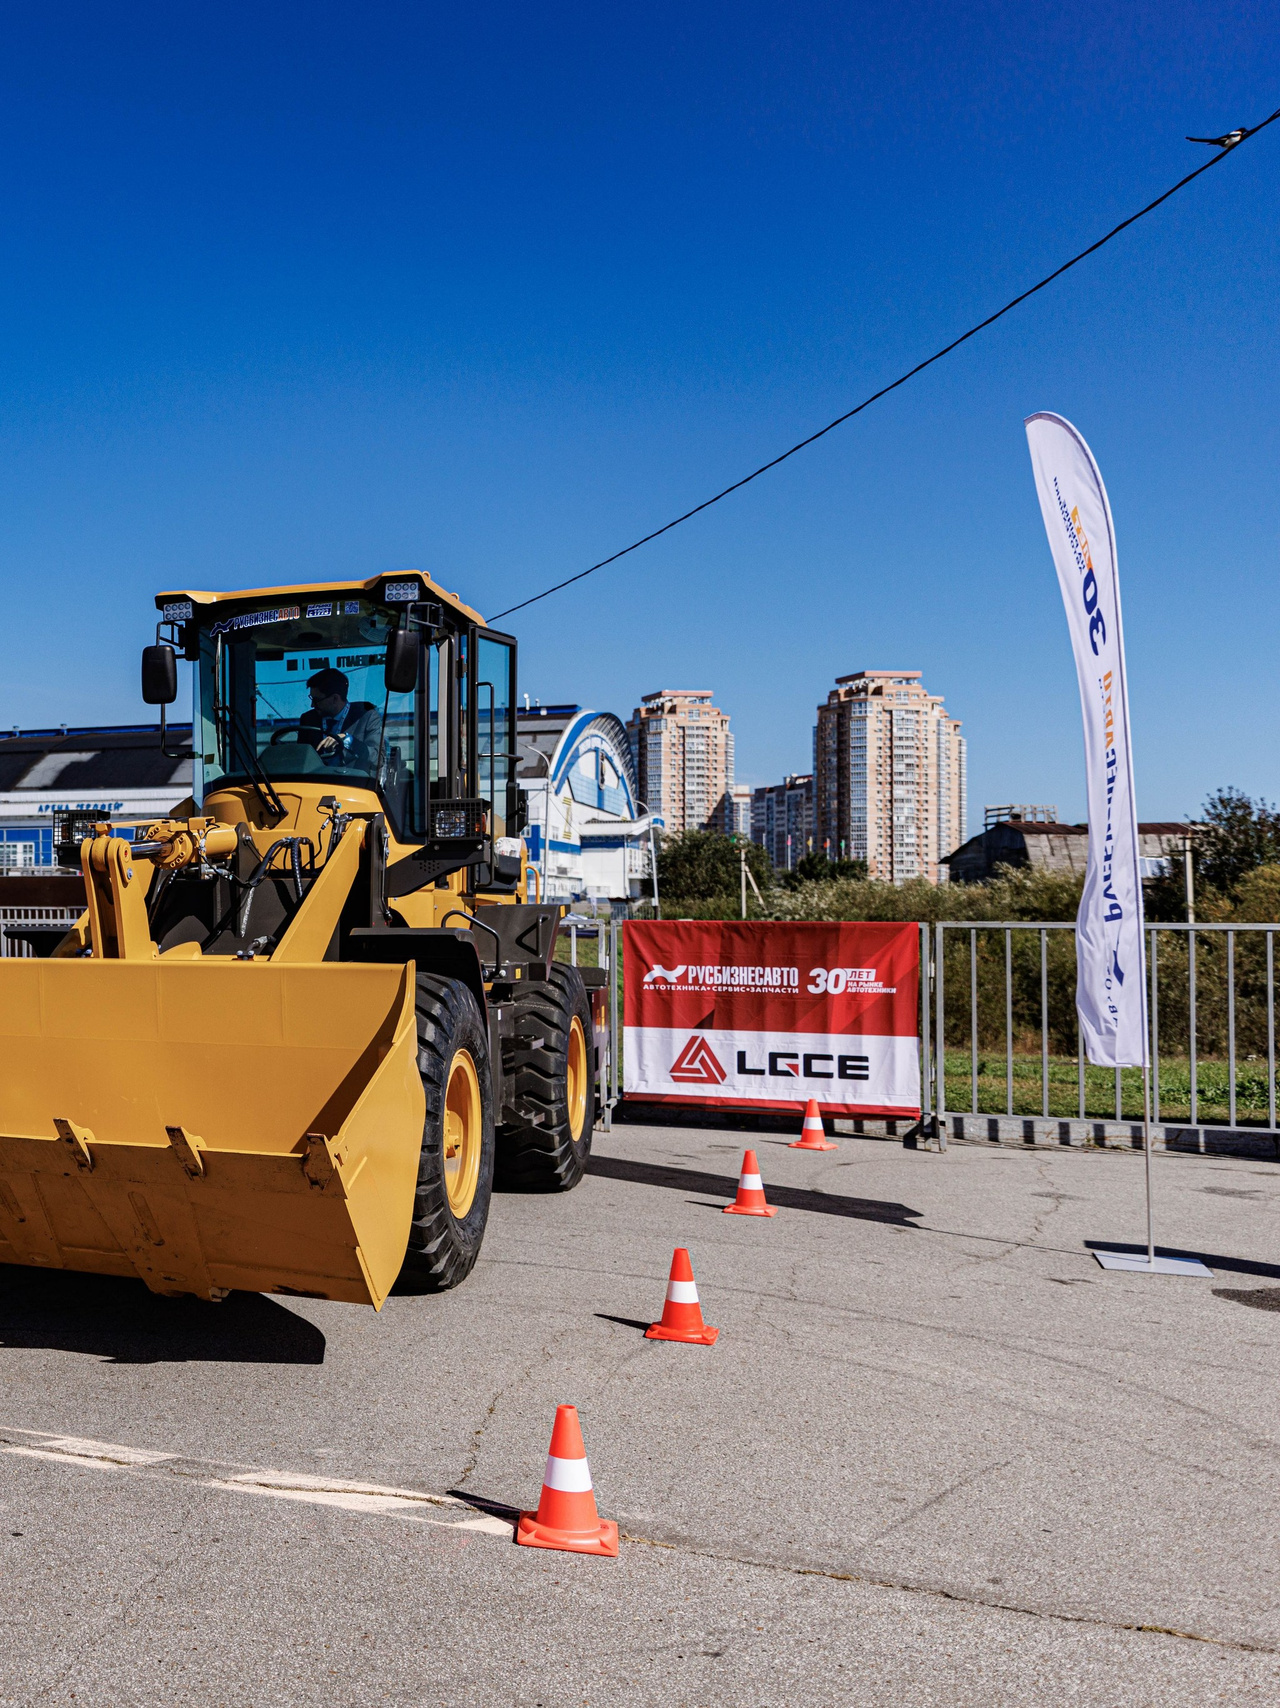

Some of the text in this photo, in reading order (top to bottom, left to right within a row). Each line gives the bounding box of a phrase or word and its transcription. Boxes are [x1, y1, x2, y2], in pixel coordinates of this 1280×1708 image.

[234, 606, 300, 630] РУСБИЗНЕСАВТО
[688, 965, 847, 994] РУСБИЗНЕСАВТО 30
[850, 970, 872, 978] ЛЕТ
[737, 1050, 869, 1080] LGCE
